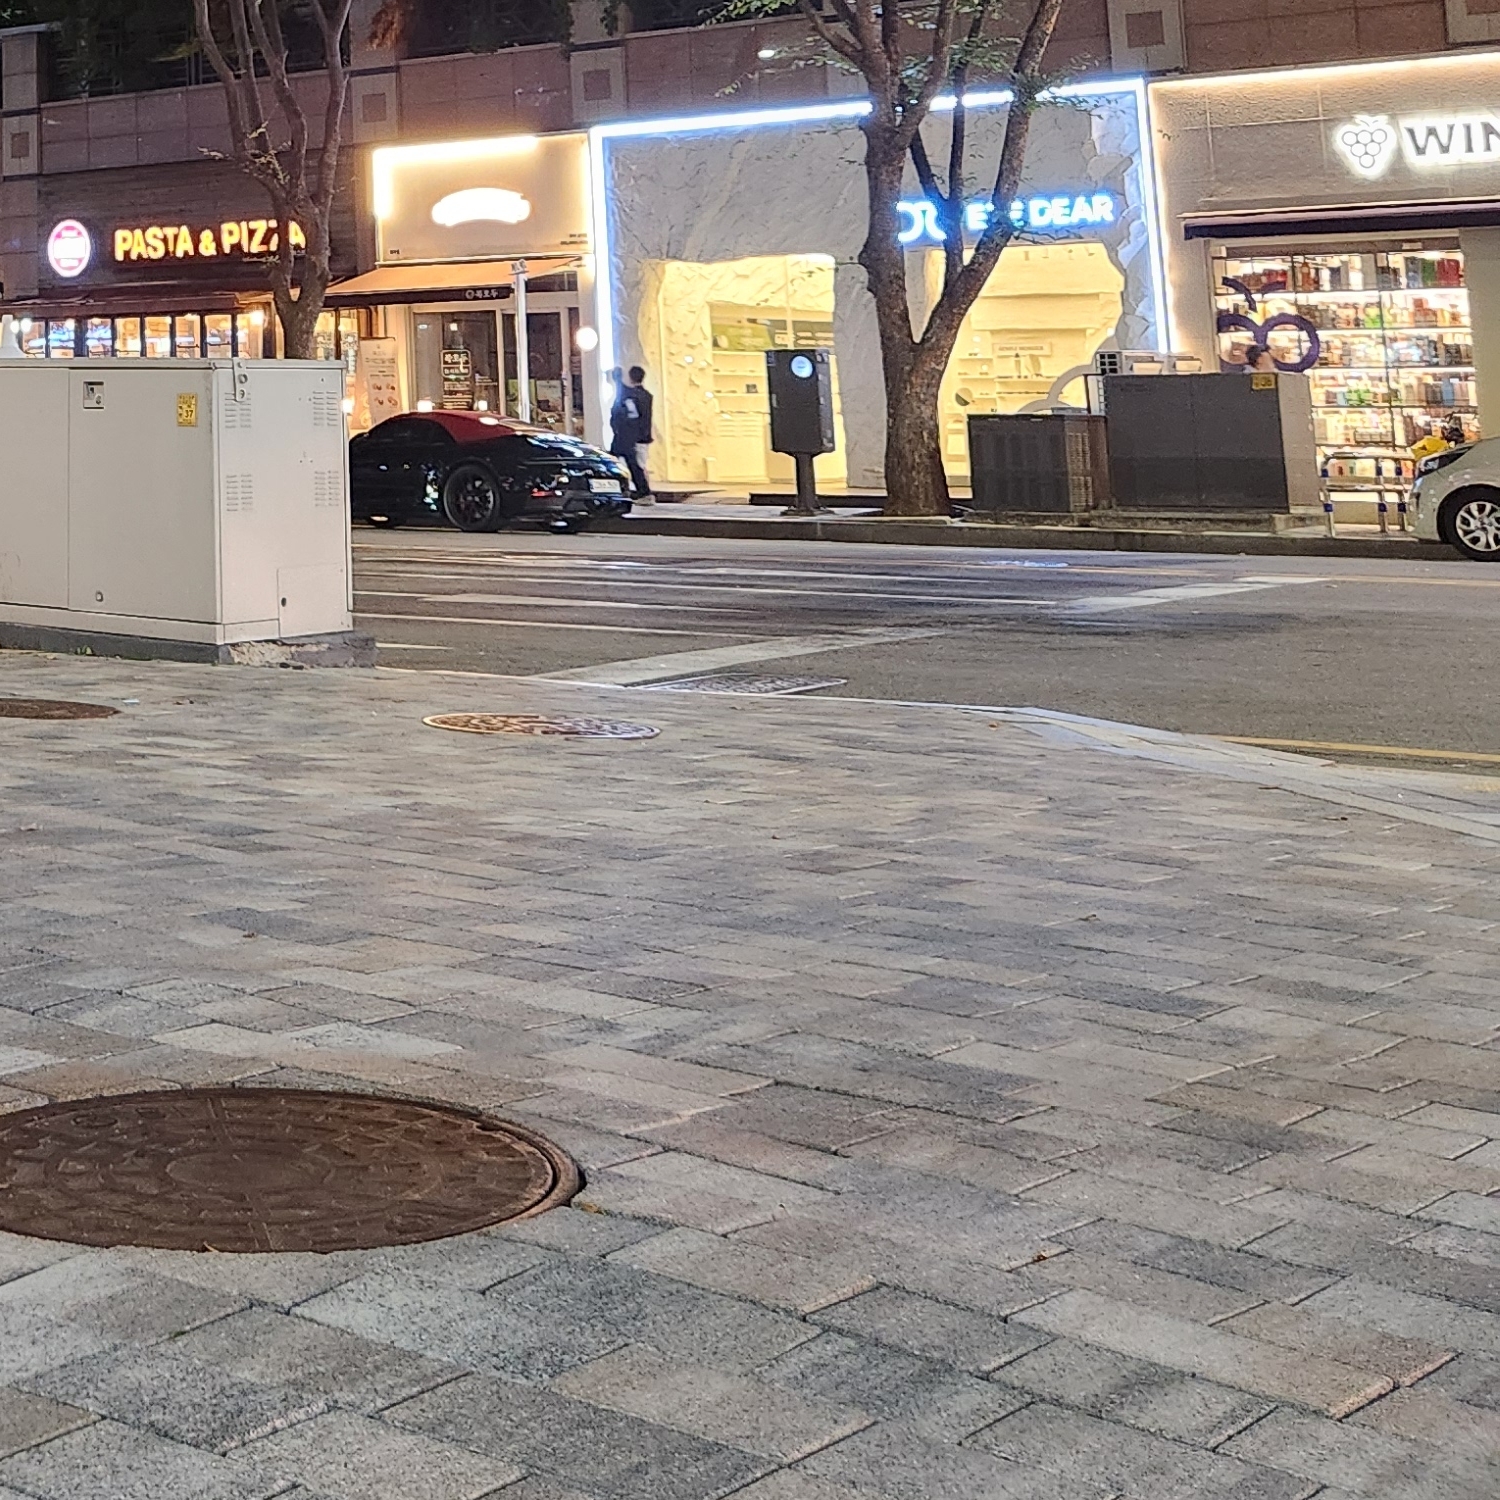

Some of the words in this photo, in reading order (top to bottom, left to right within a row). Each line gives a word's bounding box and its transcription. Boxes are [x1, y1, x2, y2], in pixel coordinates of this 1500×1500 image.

[1029, 194, 1115, 227] DEAR
[114, 224, 195, 261] PASTA
[199, 228, 218, 257] &
[185, 409, 194, 418] 37
